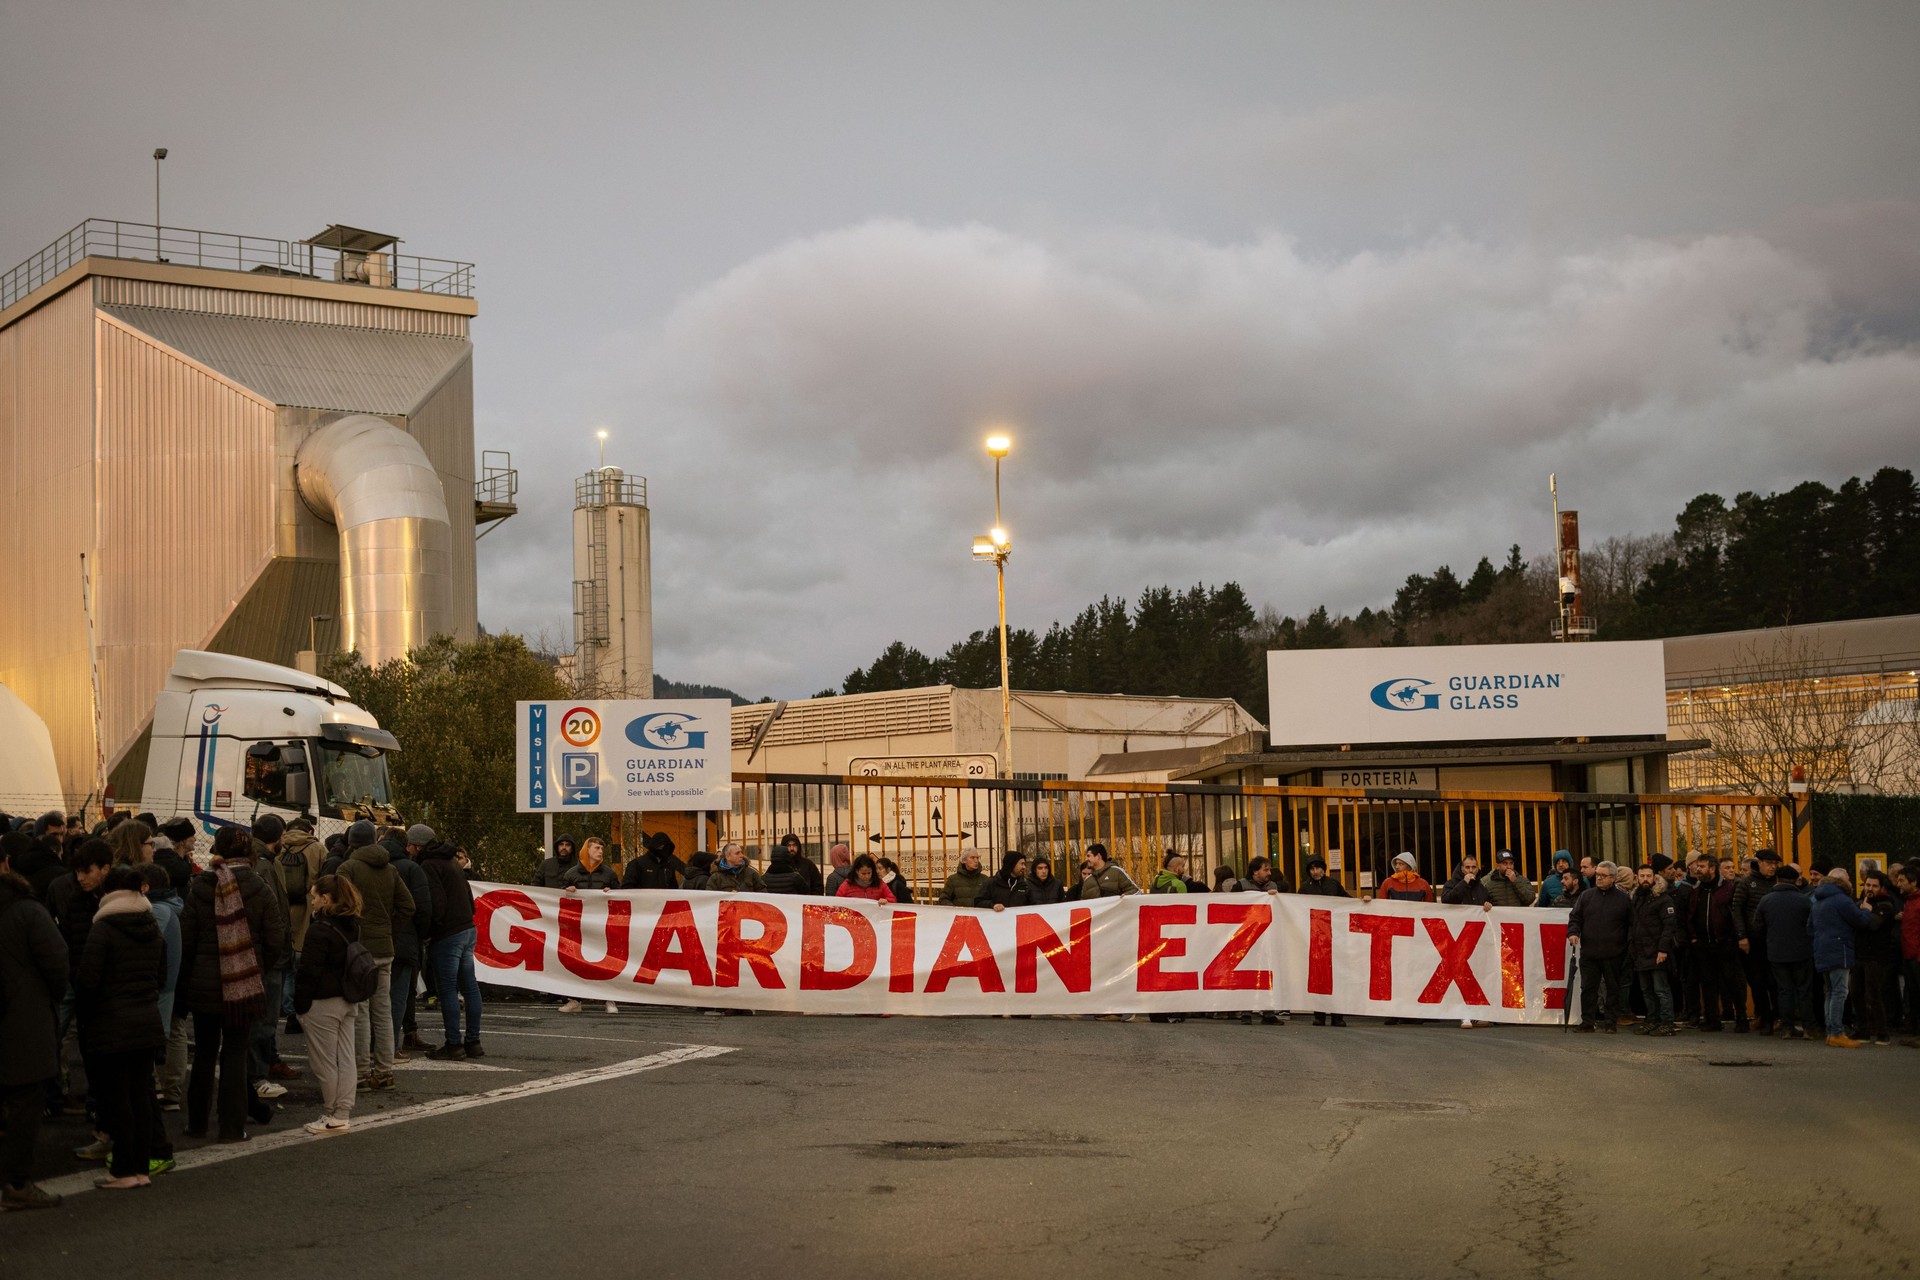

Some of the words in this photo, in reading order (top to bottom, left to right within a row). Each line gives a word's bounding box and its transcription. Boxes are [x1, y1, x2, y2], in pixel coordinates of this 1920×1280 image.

[1449, 673, 1561, 691] GUARDIAN
[1449, 694, 1519, 710] GLASS
[568, 719, 594, 735] 20
[533, 708, 543, 804] VISITAS
[626, 758, 704, 770] GUARDIAN
[884, 762, 892, 770] IN
[907, 761, 919, 769] THE
[920, 761, 941, 769] PLANT
[943, 760, 961, 768] AREA
[969, 765, 984, 774] 20
[570, 758, 592, 785] P
[626, 772, 675, 783] GLASS
[863, 768, 878, 777] 20
[627, 789, 642, 797] See
[644, 788, 670, 796] what's
[671, 788, 704, 798] possible
[473, 889, 1091, 994] GUARDIAN
[1136, 903, 1274, 993] EZ
[1308, 908, 1568, 1010] ITXI!
